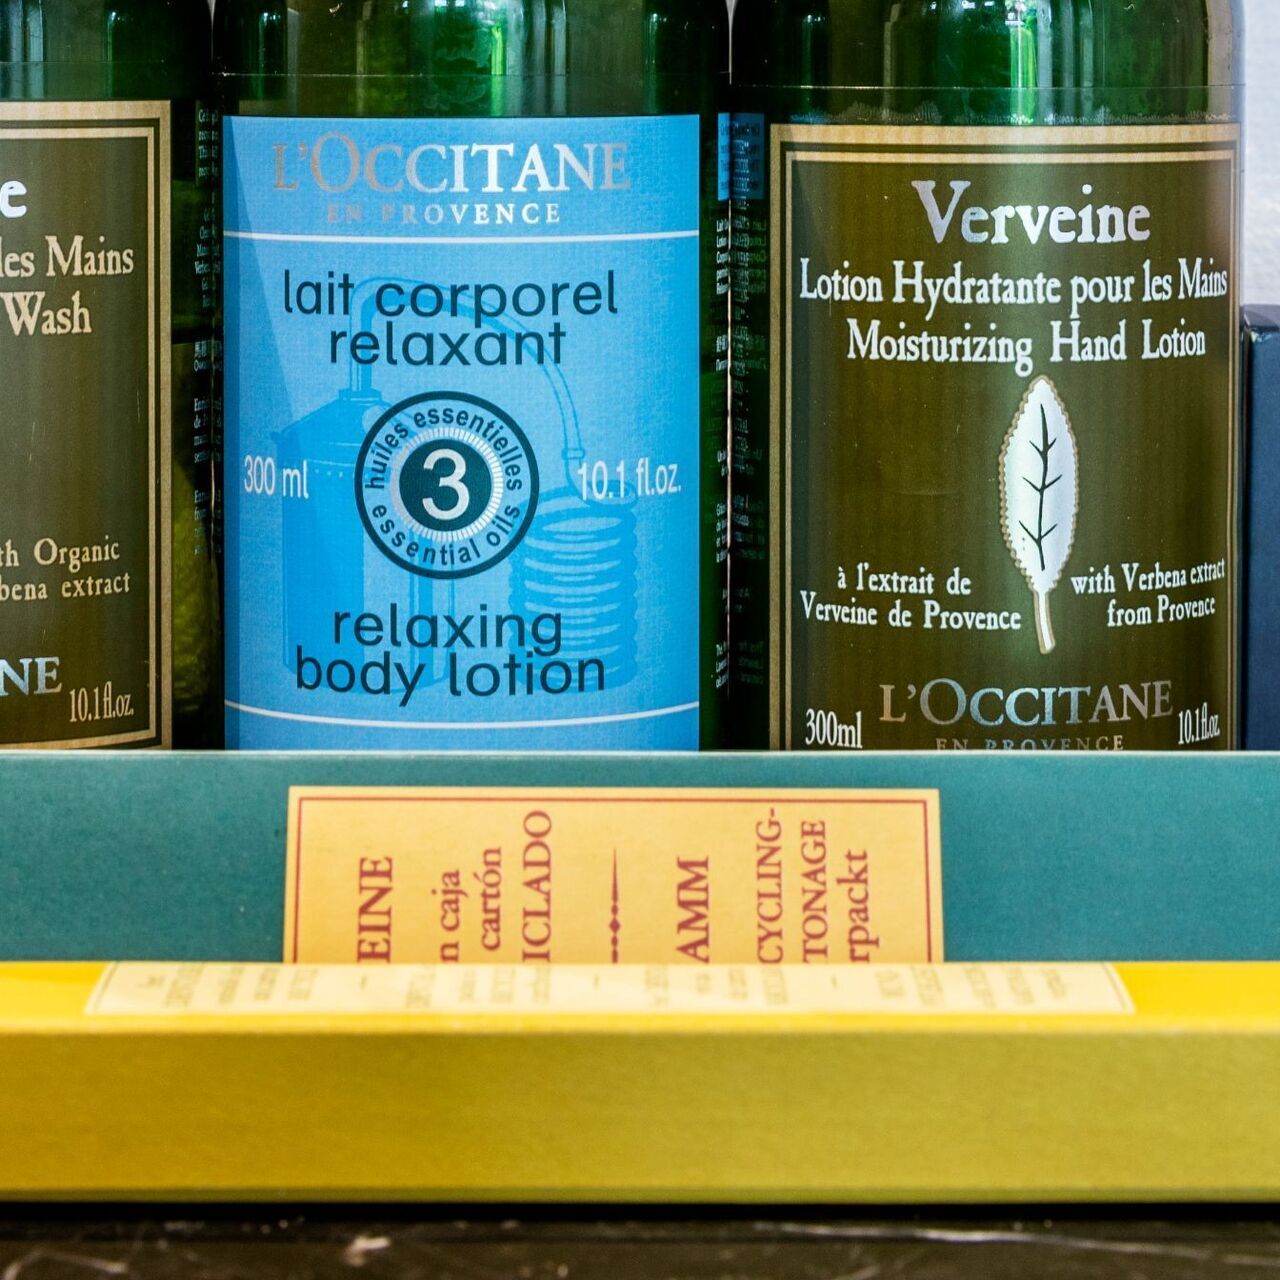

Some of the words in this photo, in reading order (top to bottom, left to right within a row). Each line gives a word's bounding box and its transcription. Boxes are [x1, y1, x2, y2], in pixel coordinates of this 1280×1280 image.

[273, 131, 631, 193] L'OCCITANE
[327, 202, 363, 223] EN
[383, 202, 560, 226] PROVENCE
[911, 180, 1151, 245] Verveine
[45, 234, 135, 277] Mains
[284, 269, 355, 316] lait
[375, 269, 618, 327] corporel
[800, 257, 884, 303] Lotion
[892, 259, 1062, 321] Hydratante
[1071, 271, 1135, 319] pour
[1143, 262, 1173, 302] les
[1178, 257, 1228, 300] Mains
[0, 290, 92, 336] Wash
[330, 320, 566, 367] relaxant
[846, 318, 1034, 377] Moisturizing
[1050, 318, 1127, 362] Hand
[1142, 318, 1206, 359] Lotion
[365, 422, 409, 489] huiles
[413, 407, 523, 491] essentielles
[243, 456, 276, 496] 300
[282, 459, 310, 500] ml
[422, 448, 470, 520] 3
[577, 460, 626, 502] 10.1
[33, 534, 120, 573] Organic
[372, 504, 481, 565] essential
[486, 505, 520, 547] oils
[61, 572, 131, 598] extract
[837, 565, 847, 589] à
[856, 561, 935, 594] l'extrait
[946, 566, 972, 596] de
[1071, 566, 1116, 596] with
[1121, 561, 1187, 592] Verbena
[1190, 558, 1226, 586] extract
[333, 603, 562, 652] relaxing
[800, 589, 878, 626] Verveine
[888, 599, 912, 628] de
[923, 599, 1022, 631] Provence
[1106, 596, 1152, 628] from
[1157, 591, 1217, 624] Provence
[296, 646, 426, 708] body
[450, 653, 605, 697] lotion
[879, 677, 1174, 727] L'OCCITANE
[805, 707, 863, 749] 300ml
[936, 737, 968, 751] EN
[985, 734, 1125, 751] PROVENCE
[431, 869, 469, 932] caja
[473, 847, 502, 951] cartón
